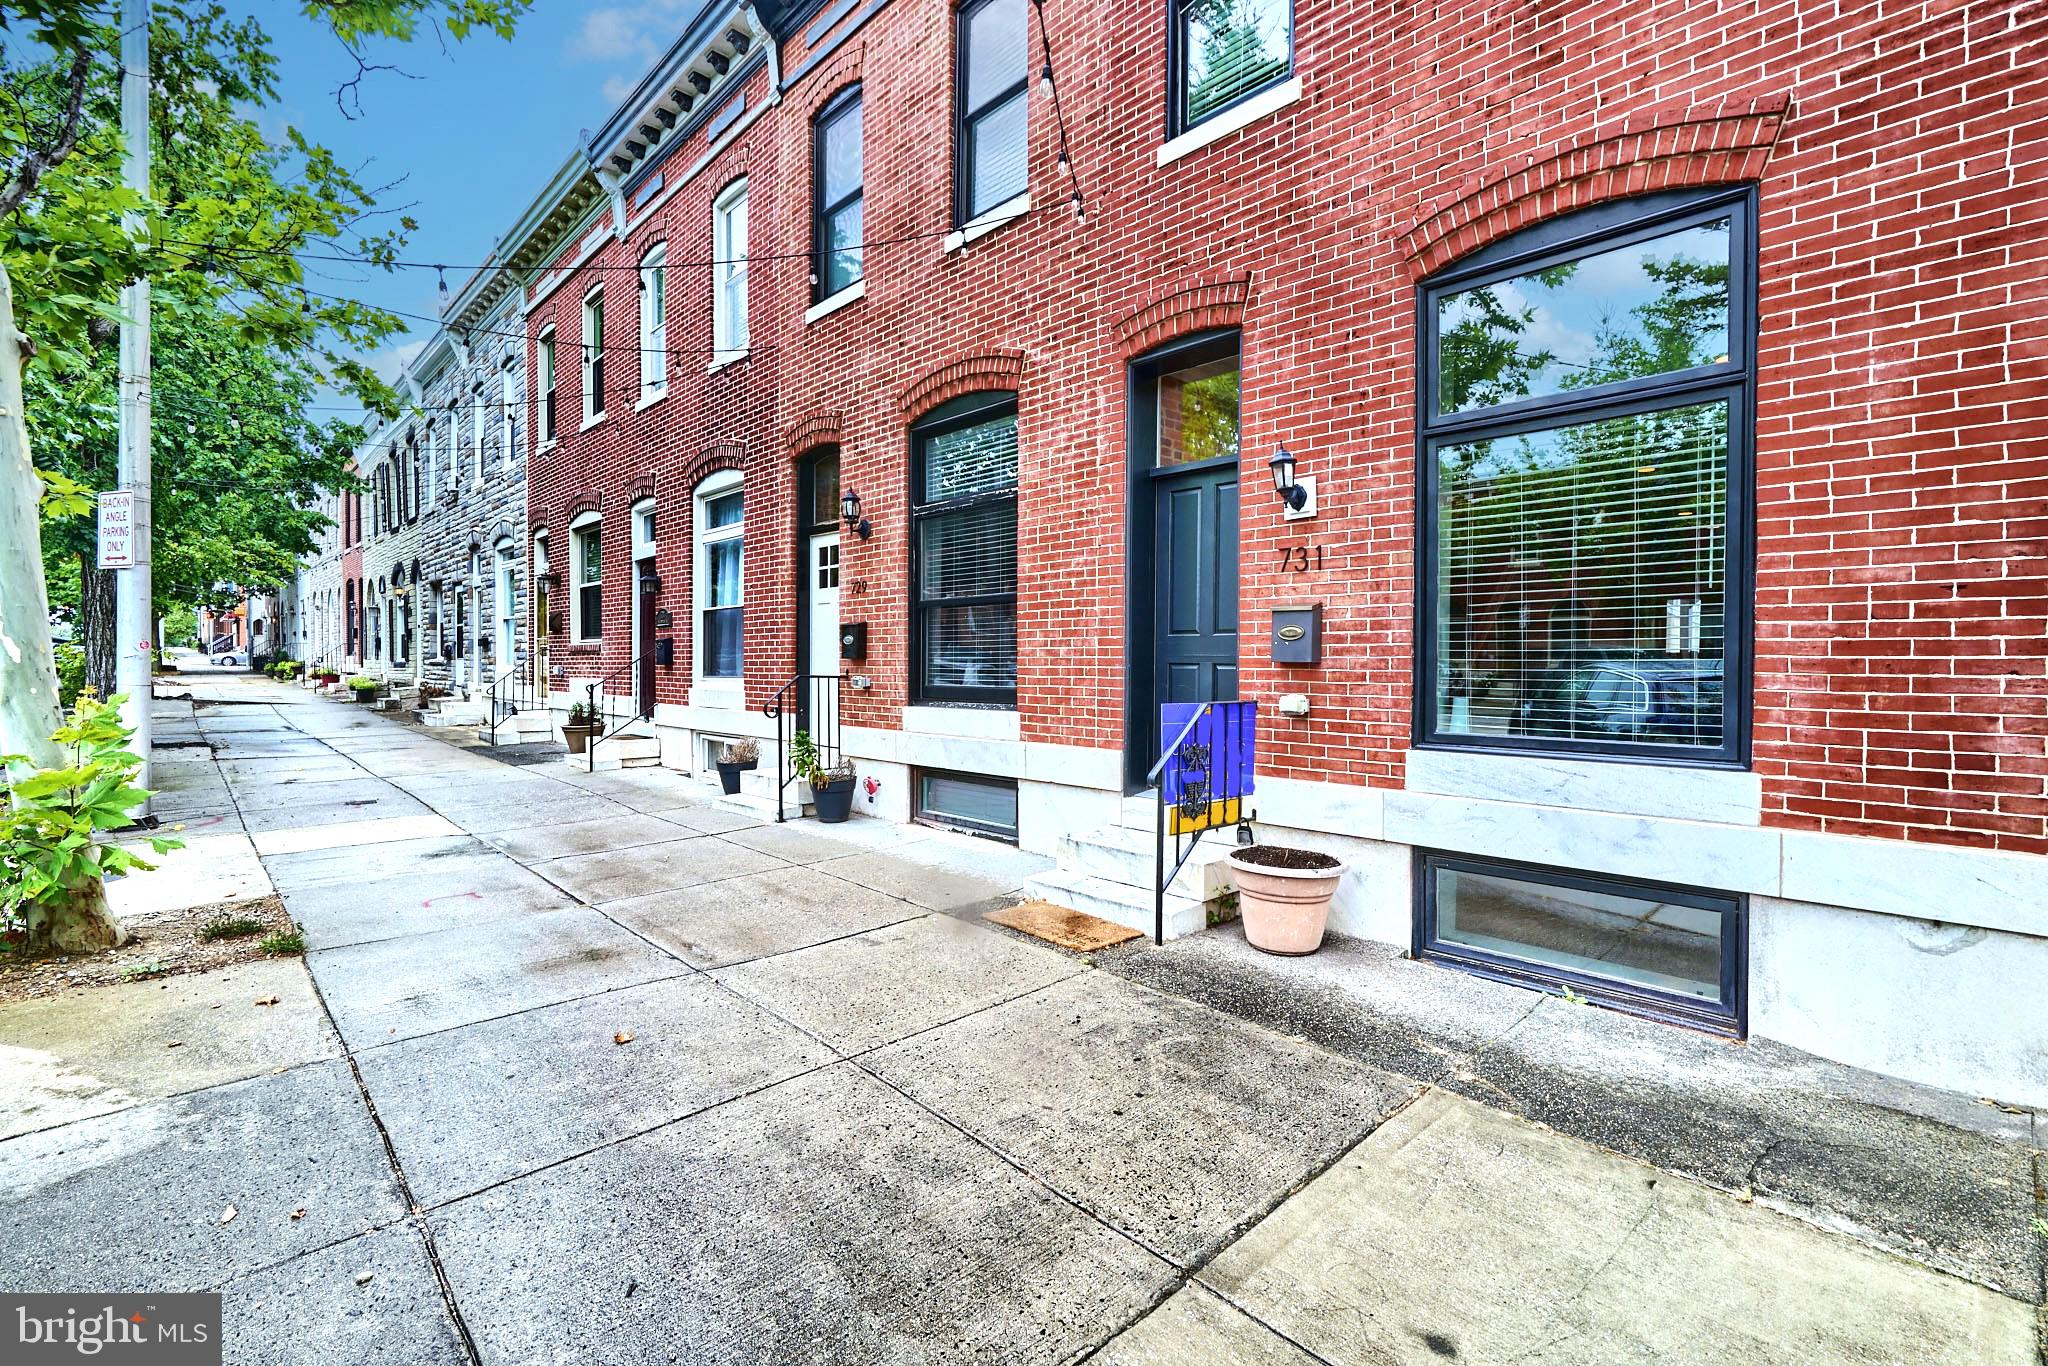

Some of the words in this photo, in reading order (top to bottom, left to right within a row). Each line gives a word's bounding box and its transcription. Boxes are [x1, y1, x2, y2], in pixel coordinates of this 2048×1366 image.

[103, 496, 130, 508] BACK-IN
[106, 511, 127, 522] ANGLE
[102, 526, 129, 537] PARKING
[106, 541, 124, 552] ONLY
[1279, 545, 1322, 572] 731
[850, 581, 868, 594] 729
